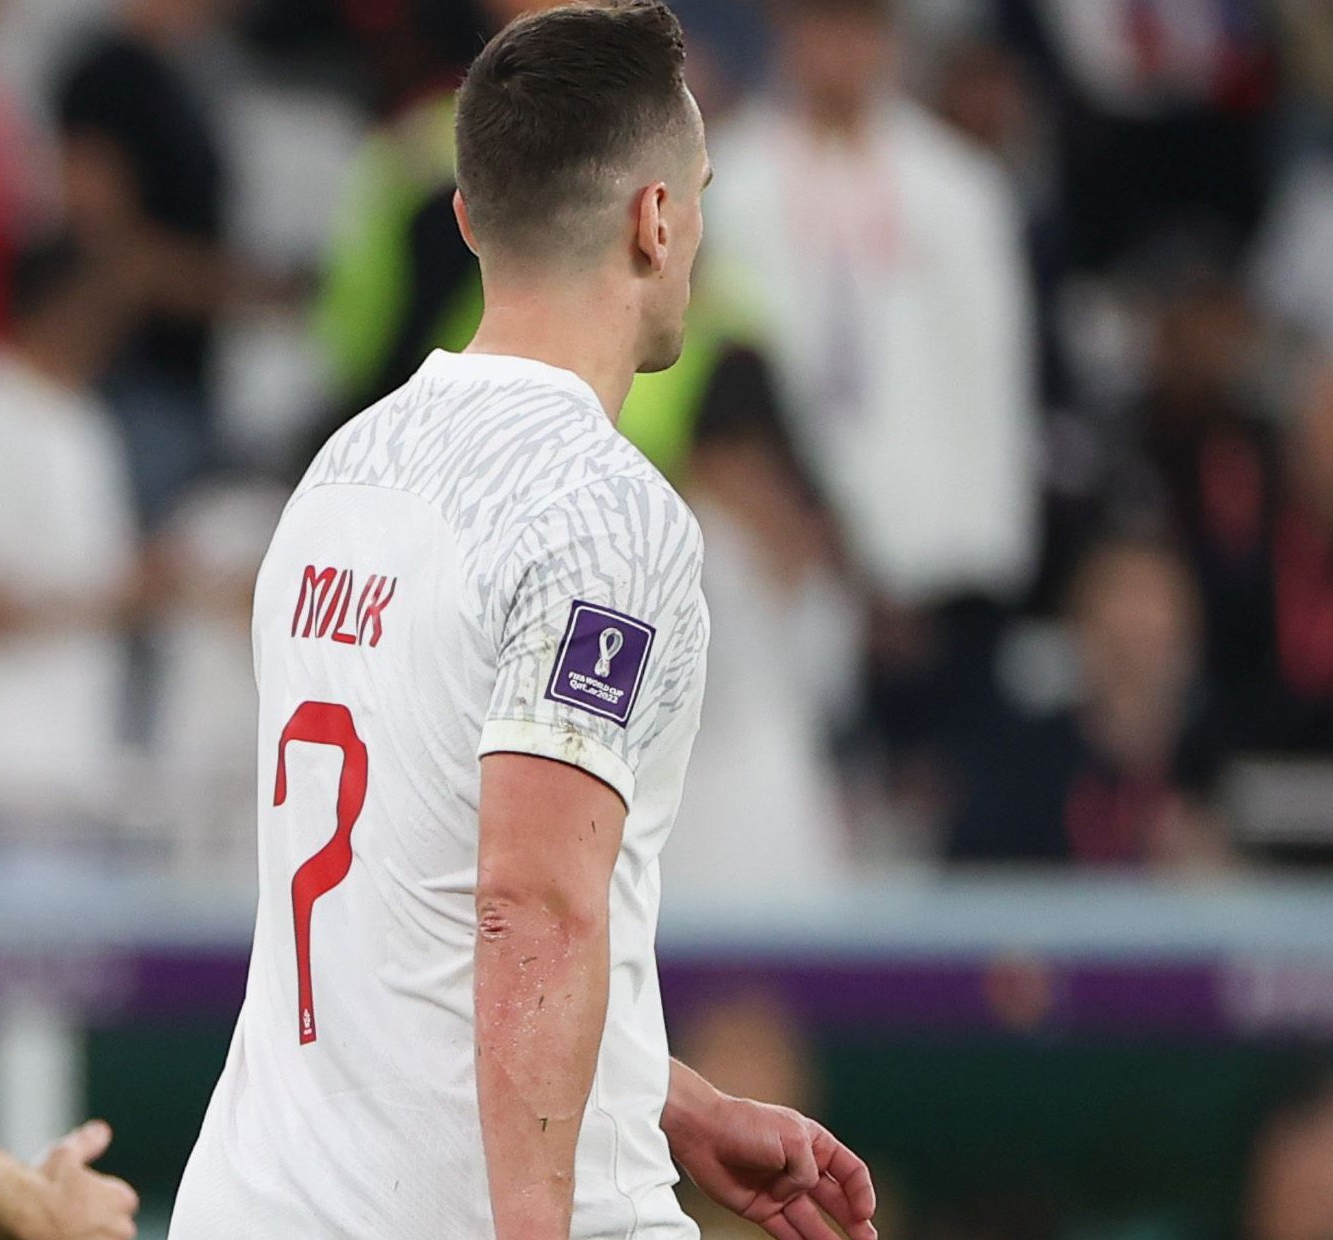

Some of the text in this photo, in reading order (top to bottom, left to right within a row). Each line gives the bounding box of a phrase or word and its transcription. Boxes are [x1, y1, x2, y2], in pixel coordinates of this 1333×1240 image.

[568, 671, 586, 682] FIFA
[586, 677, 610, 691] WORLD
[272, 700, 368, 1046] 7
